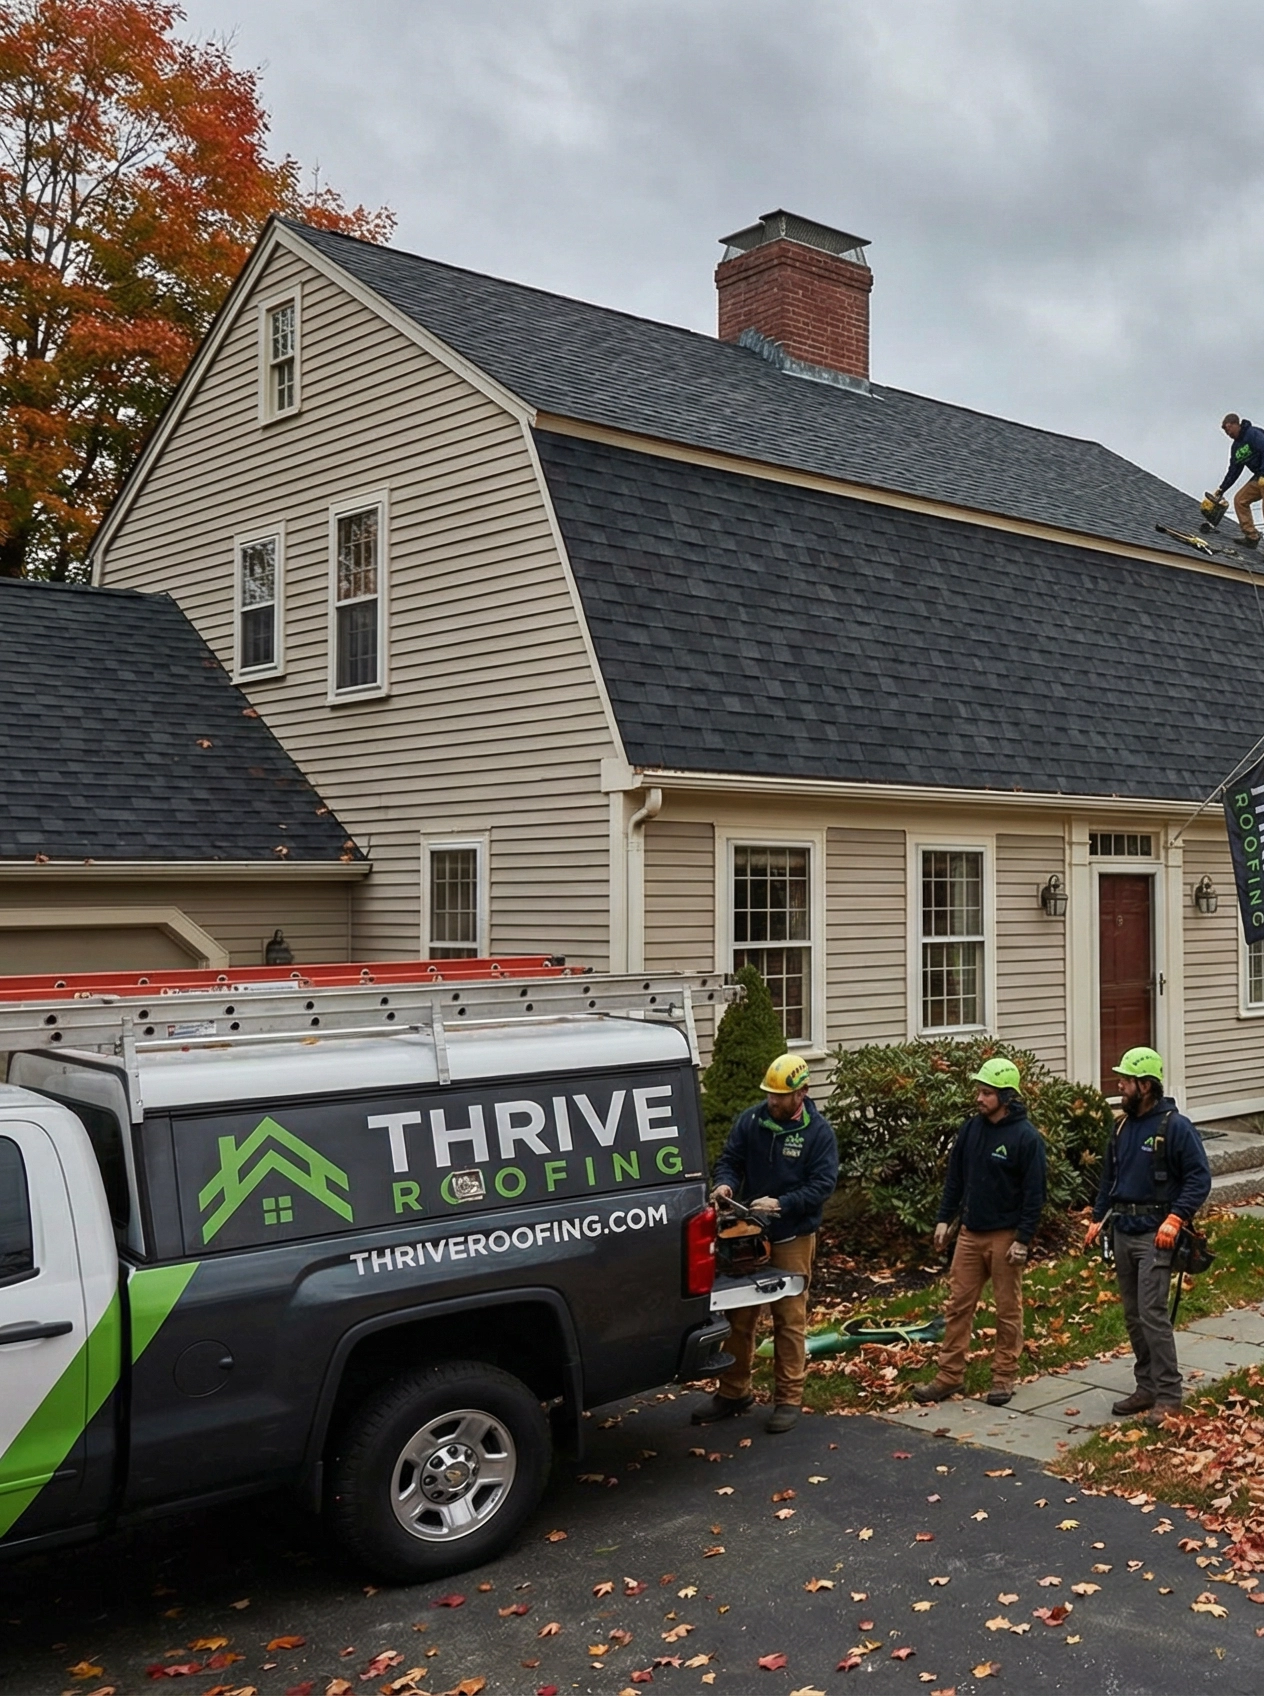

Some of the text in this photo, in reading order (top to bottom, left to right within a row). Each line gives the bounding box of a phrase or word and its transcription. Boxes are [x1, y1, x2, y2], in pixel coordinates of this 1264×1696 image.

[1235, 793, 1264, 927] ROOFING
[367, 1086, 678, 1173] THRIVE
[350, 1204, 668, 1275] THRIVEROOFING.COM
